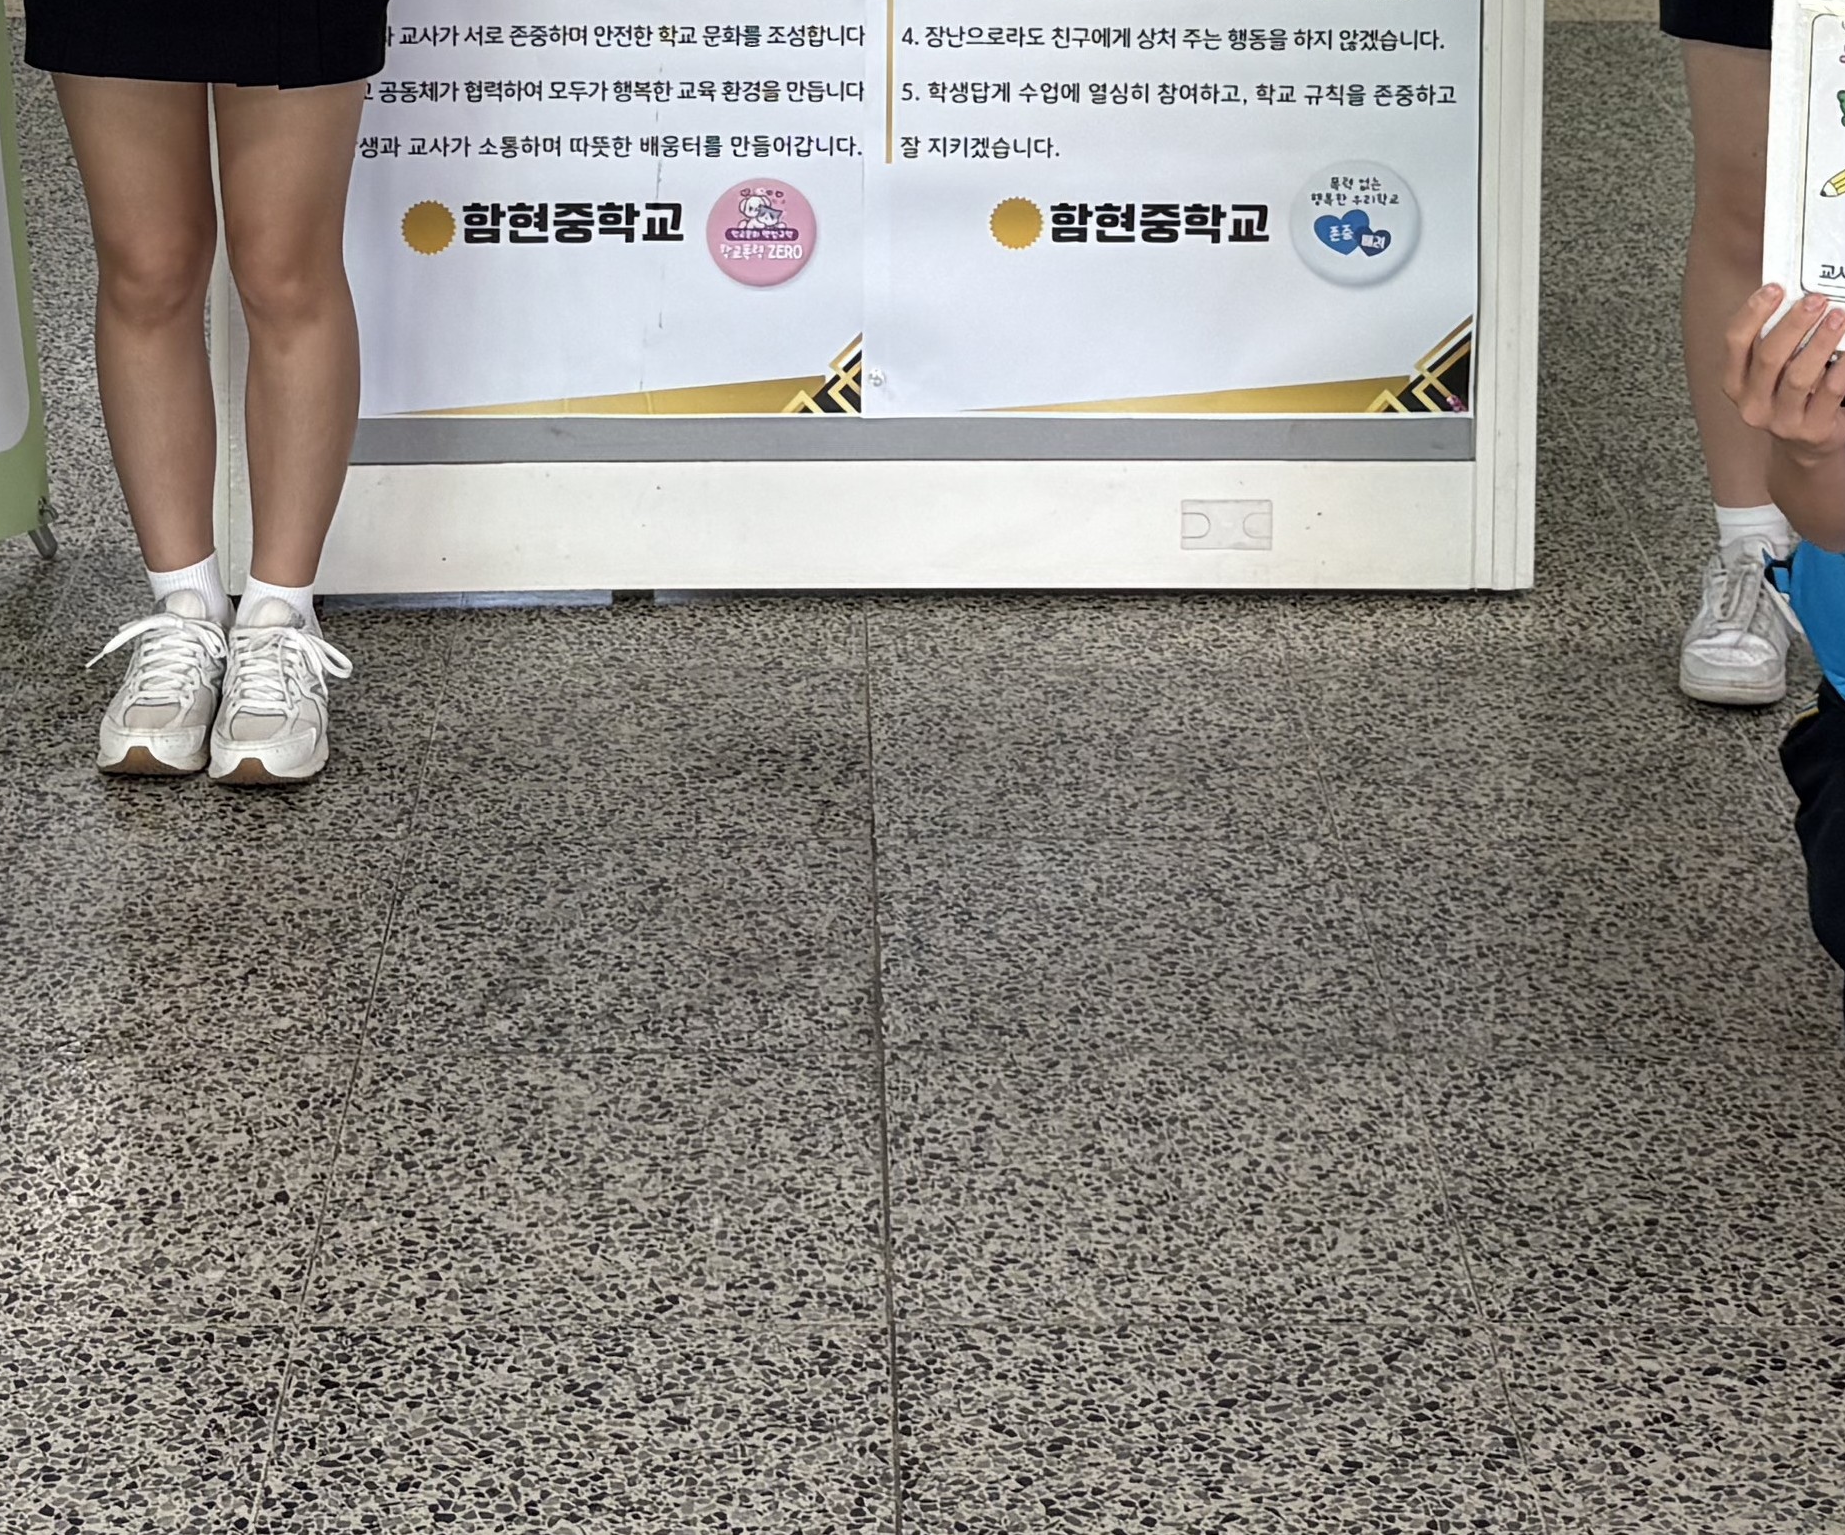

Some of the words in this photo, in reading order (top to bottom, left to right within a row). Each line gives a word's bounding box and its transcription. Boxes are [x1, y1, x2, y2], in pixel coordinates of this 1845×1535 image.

[901, 27, 920, 46] 4.
[925, 26, 1045, 49] 장난으로라도
[1051, 27, 1131, 49] 친구에게
[1137, 27, 1176, 50] 상처
[1182, 28, 1222, 50] 주는
[1227, 28, 1288, 51] 행동을
[1294, 29, 1333, 51] 하지
[1339, 29, 1445, 52] 않겠습니다.
[408, 136, 471, 158] 교사가
[479, 136, 562, 158] 소통하며
[570, 136, 632, 158] 따뜻한
[640, 136, 723, 158] 배움터를
[730, 136, 863, 158] 만들어갑니다.
[462, 201, 685, 245] 함현중학교
[1049, 202, 1271, 245] 함현중학교
[768, 245, 803, 259] ZERO
